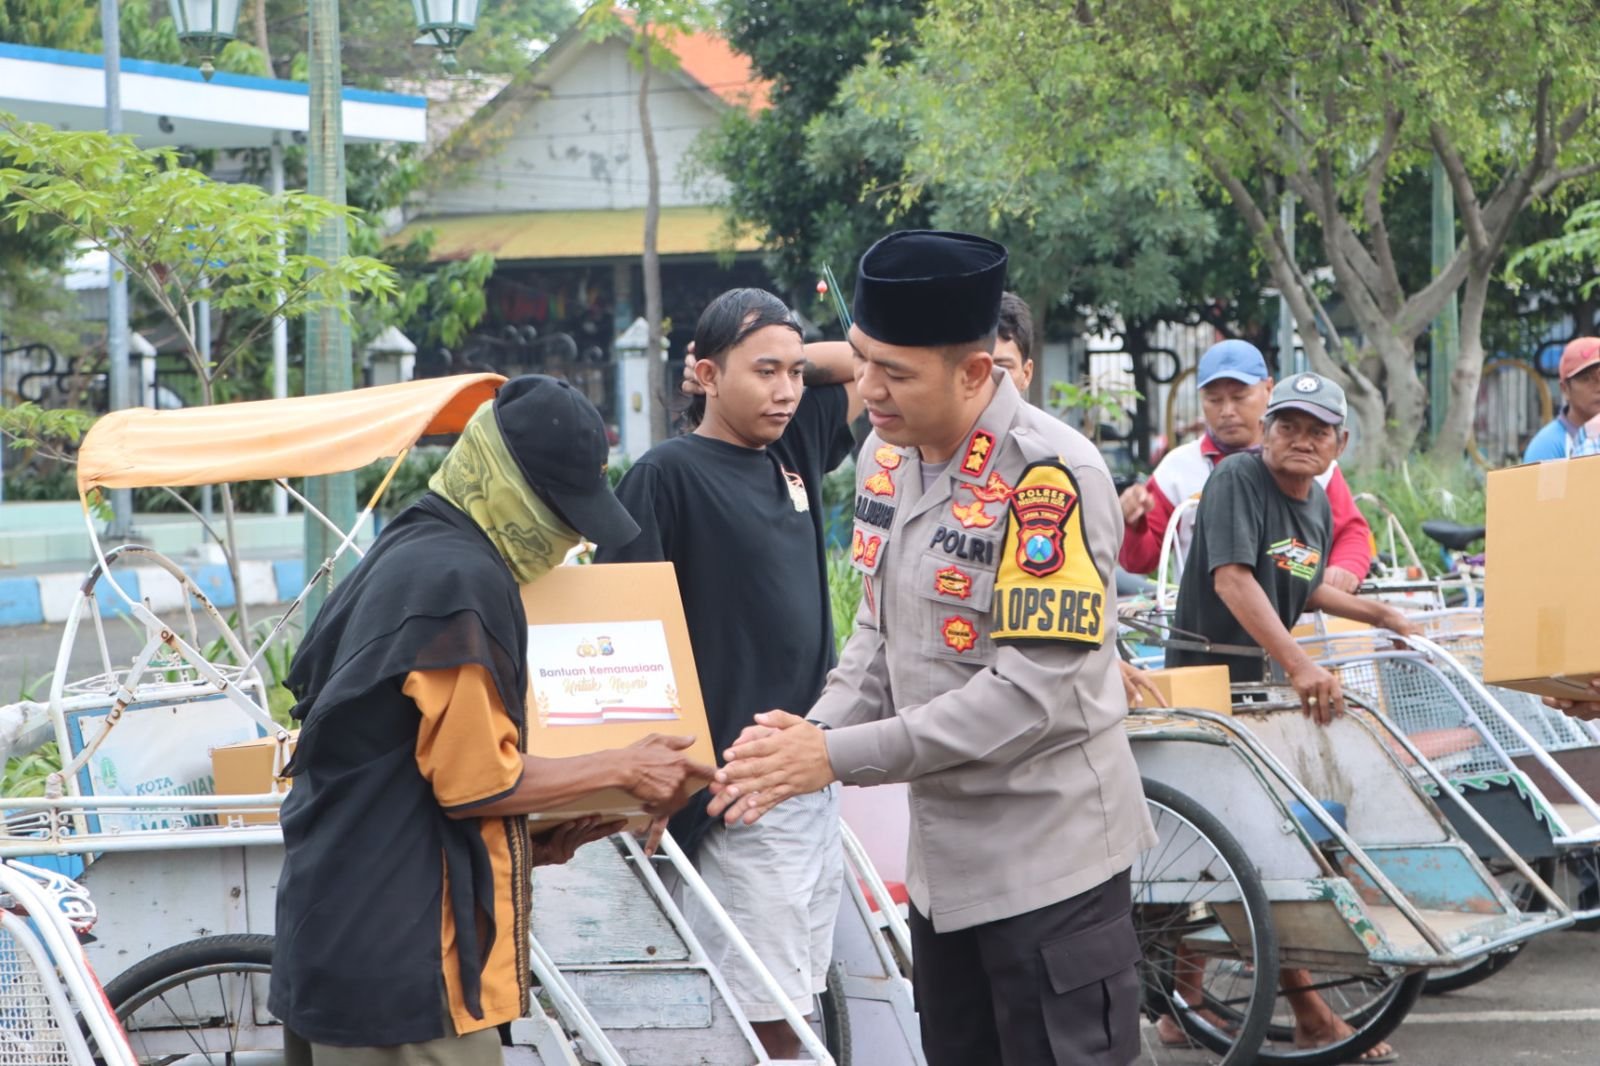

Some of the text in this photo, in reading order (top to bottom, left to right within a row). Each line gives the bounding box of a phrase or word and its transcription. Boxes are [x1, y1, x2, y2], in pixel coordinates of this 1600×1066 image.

[1018, 488, 1066, 500] POLRES
[930, 525, 993, 565] POLRI
[539, 663, 664, 677] Bantuan Kemanusiaan
[136, 776, 174, 796] KOTA
